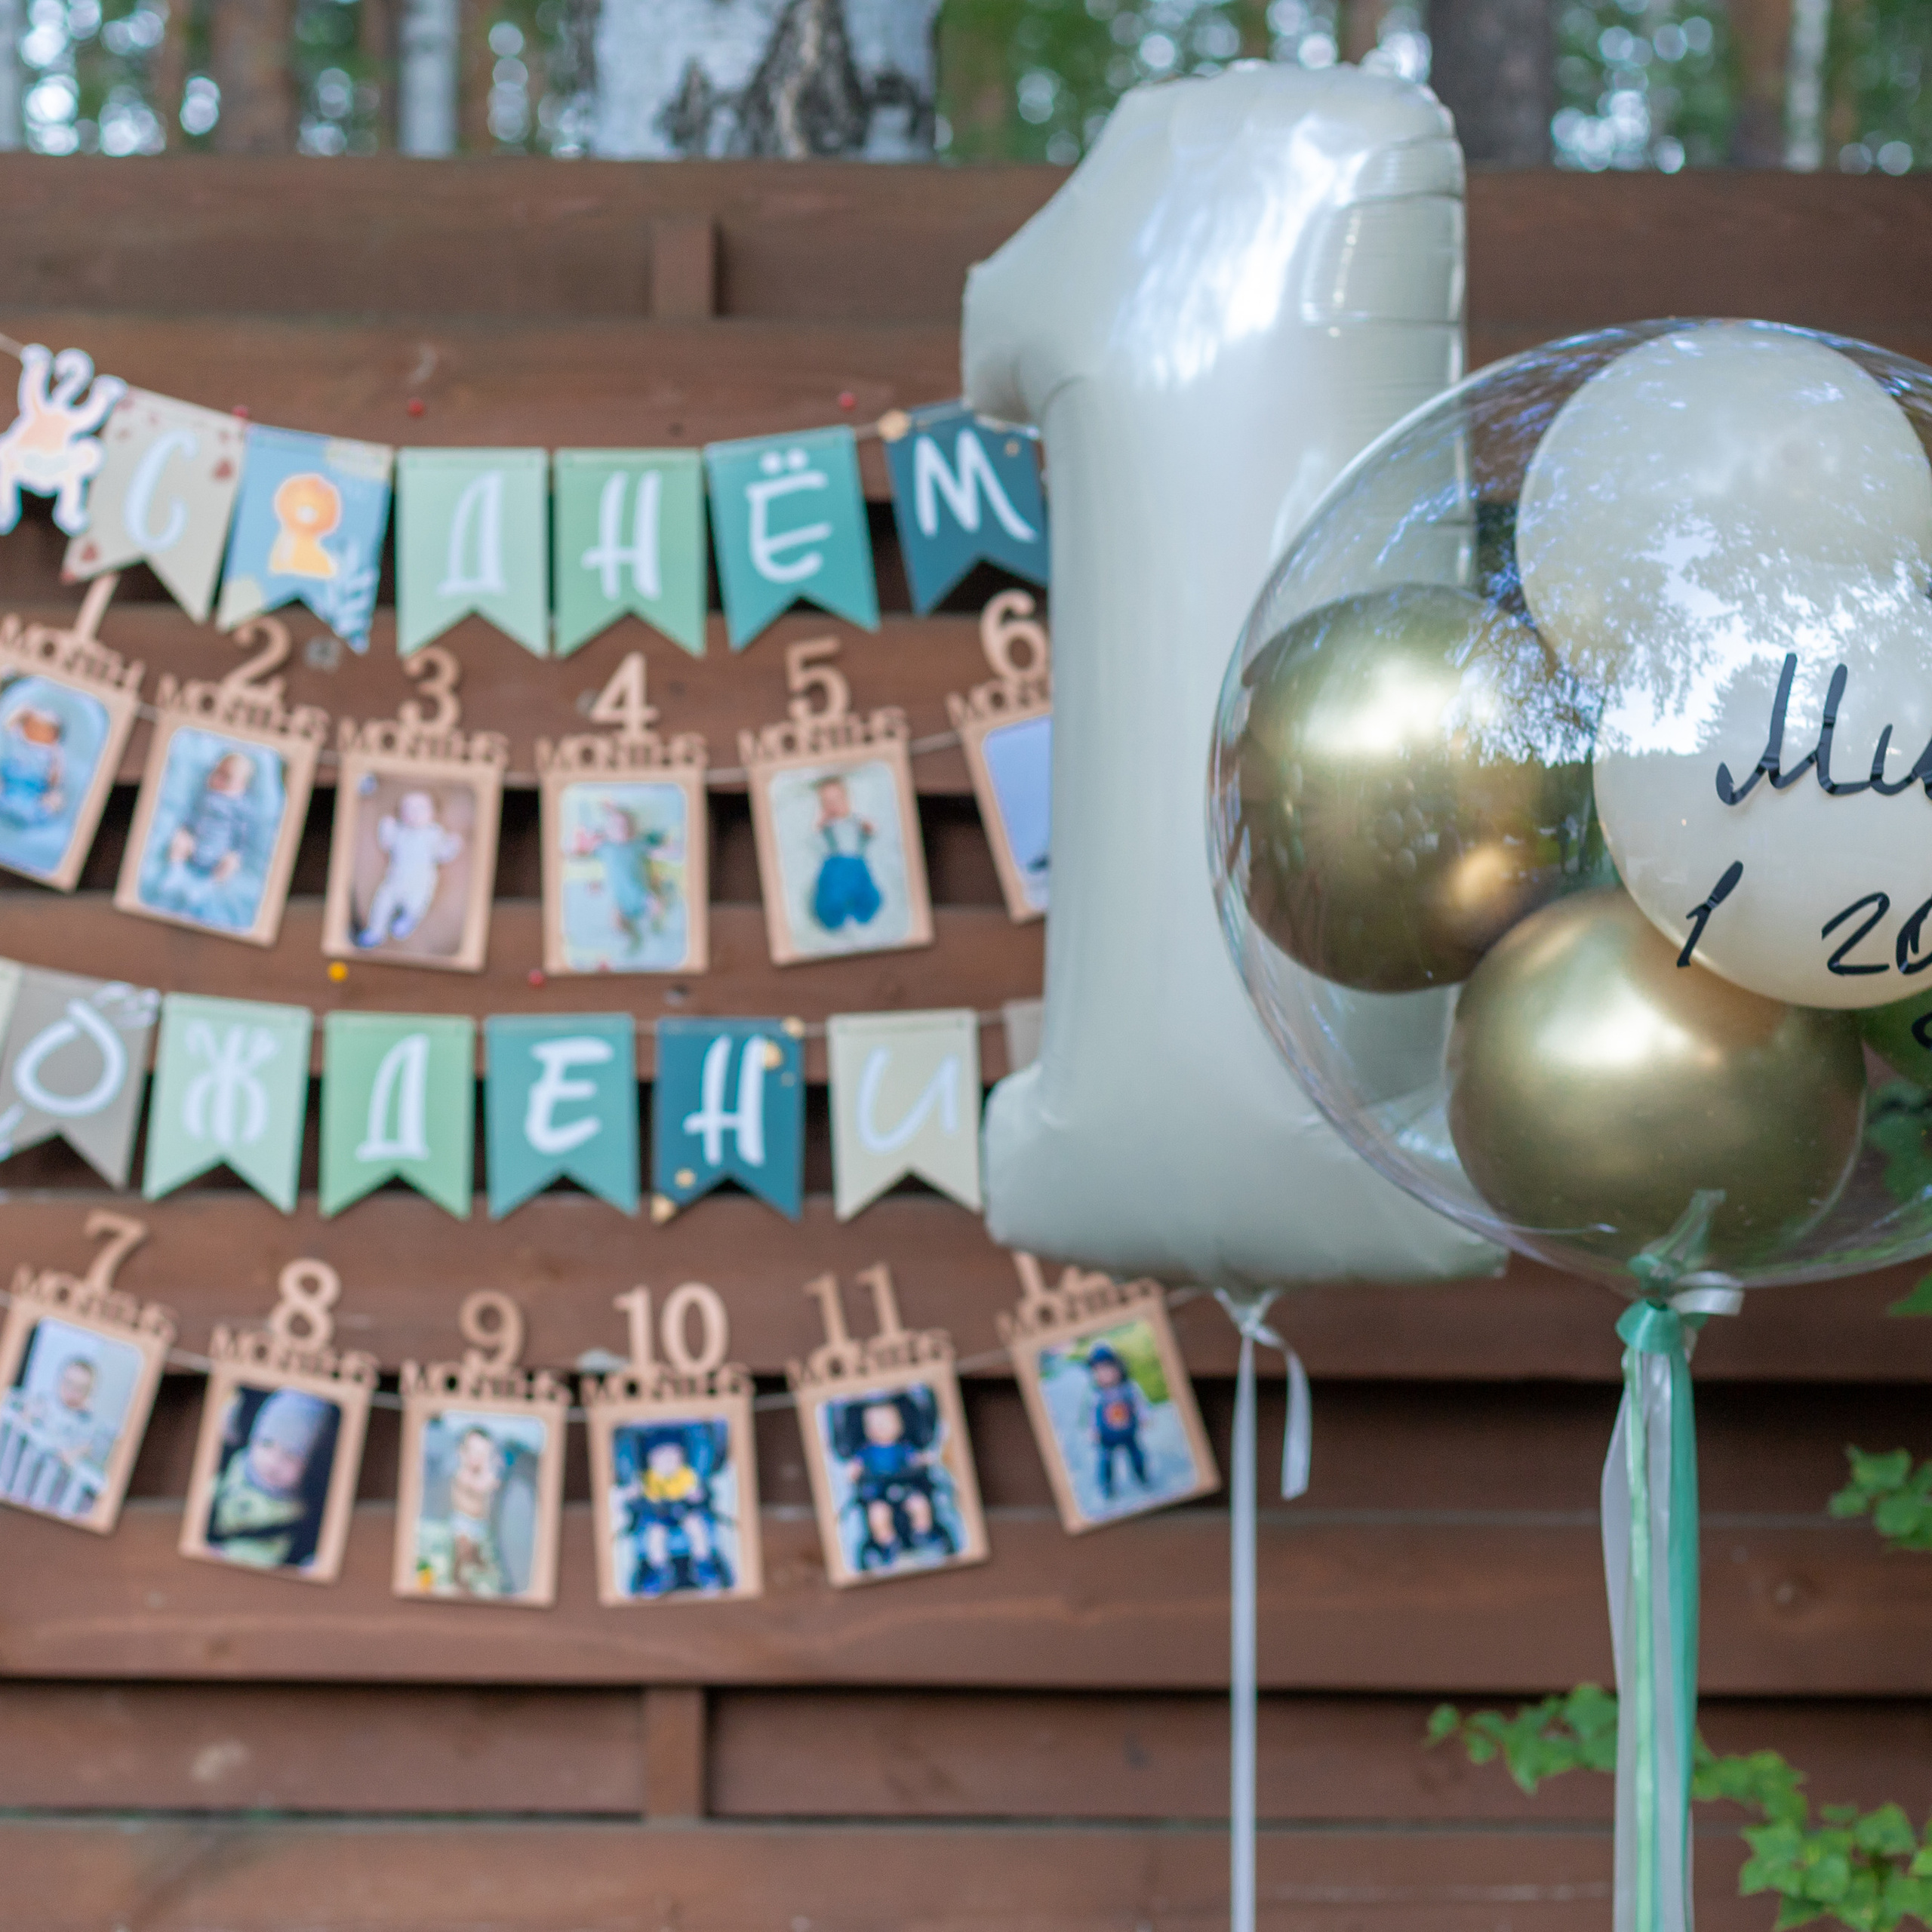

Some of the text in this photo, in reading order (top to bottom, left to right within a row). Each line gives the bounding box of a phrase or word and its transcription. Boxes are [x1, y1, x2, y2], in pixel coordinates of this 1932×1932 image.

[436, 428, 1037, 599] ДНЁМ
[223, 615, 292, 698] 2
[980, 588, 1048, 679] 6
[398, 647, 460, 736] 3
[589, 651, 659, 738] 4
[786, 637, 851, 721] 5
[1716, 654, 1932, 805] Ми
[1677, 860, 1743, 968] 1
[13, 997, 961, 1166] ОЖДЕНИ
[85, 1210, 148, 1291] 7
[269, 1257, 340, 1352] 8
[459, 1290, 523, 1375] 9
[613, 1281, 730, 1372] 10
[801, 1262, 902, 1347] 11
